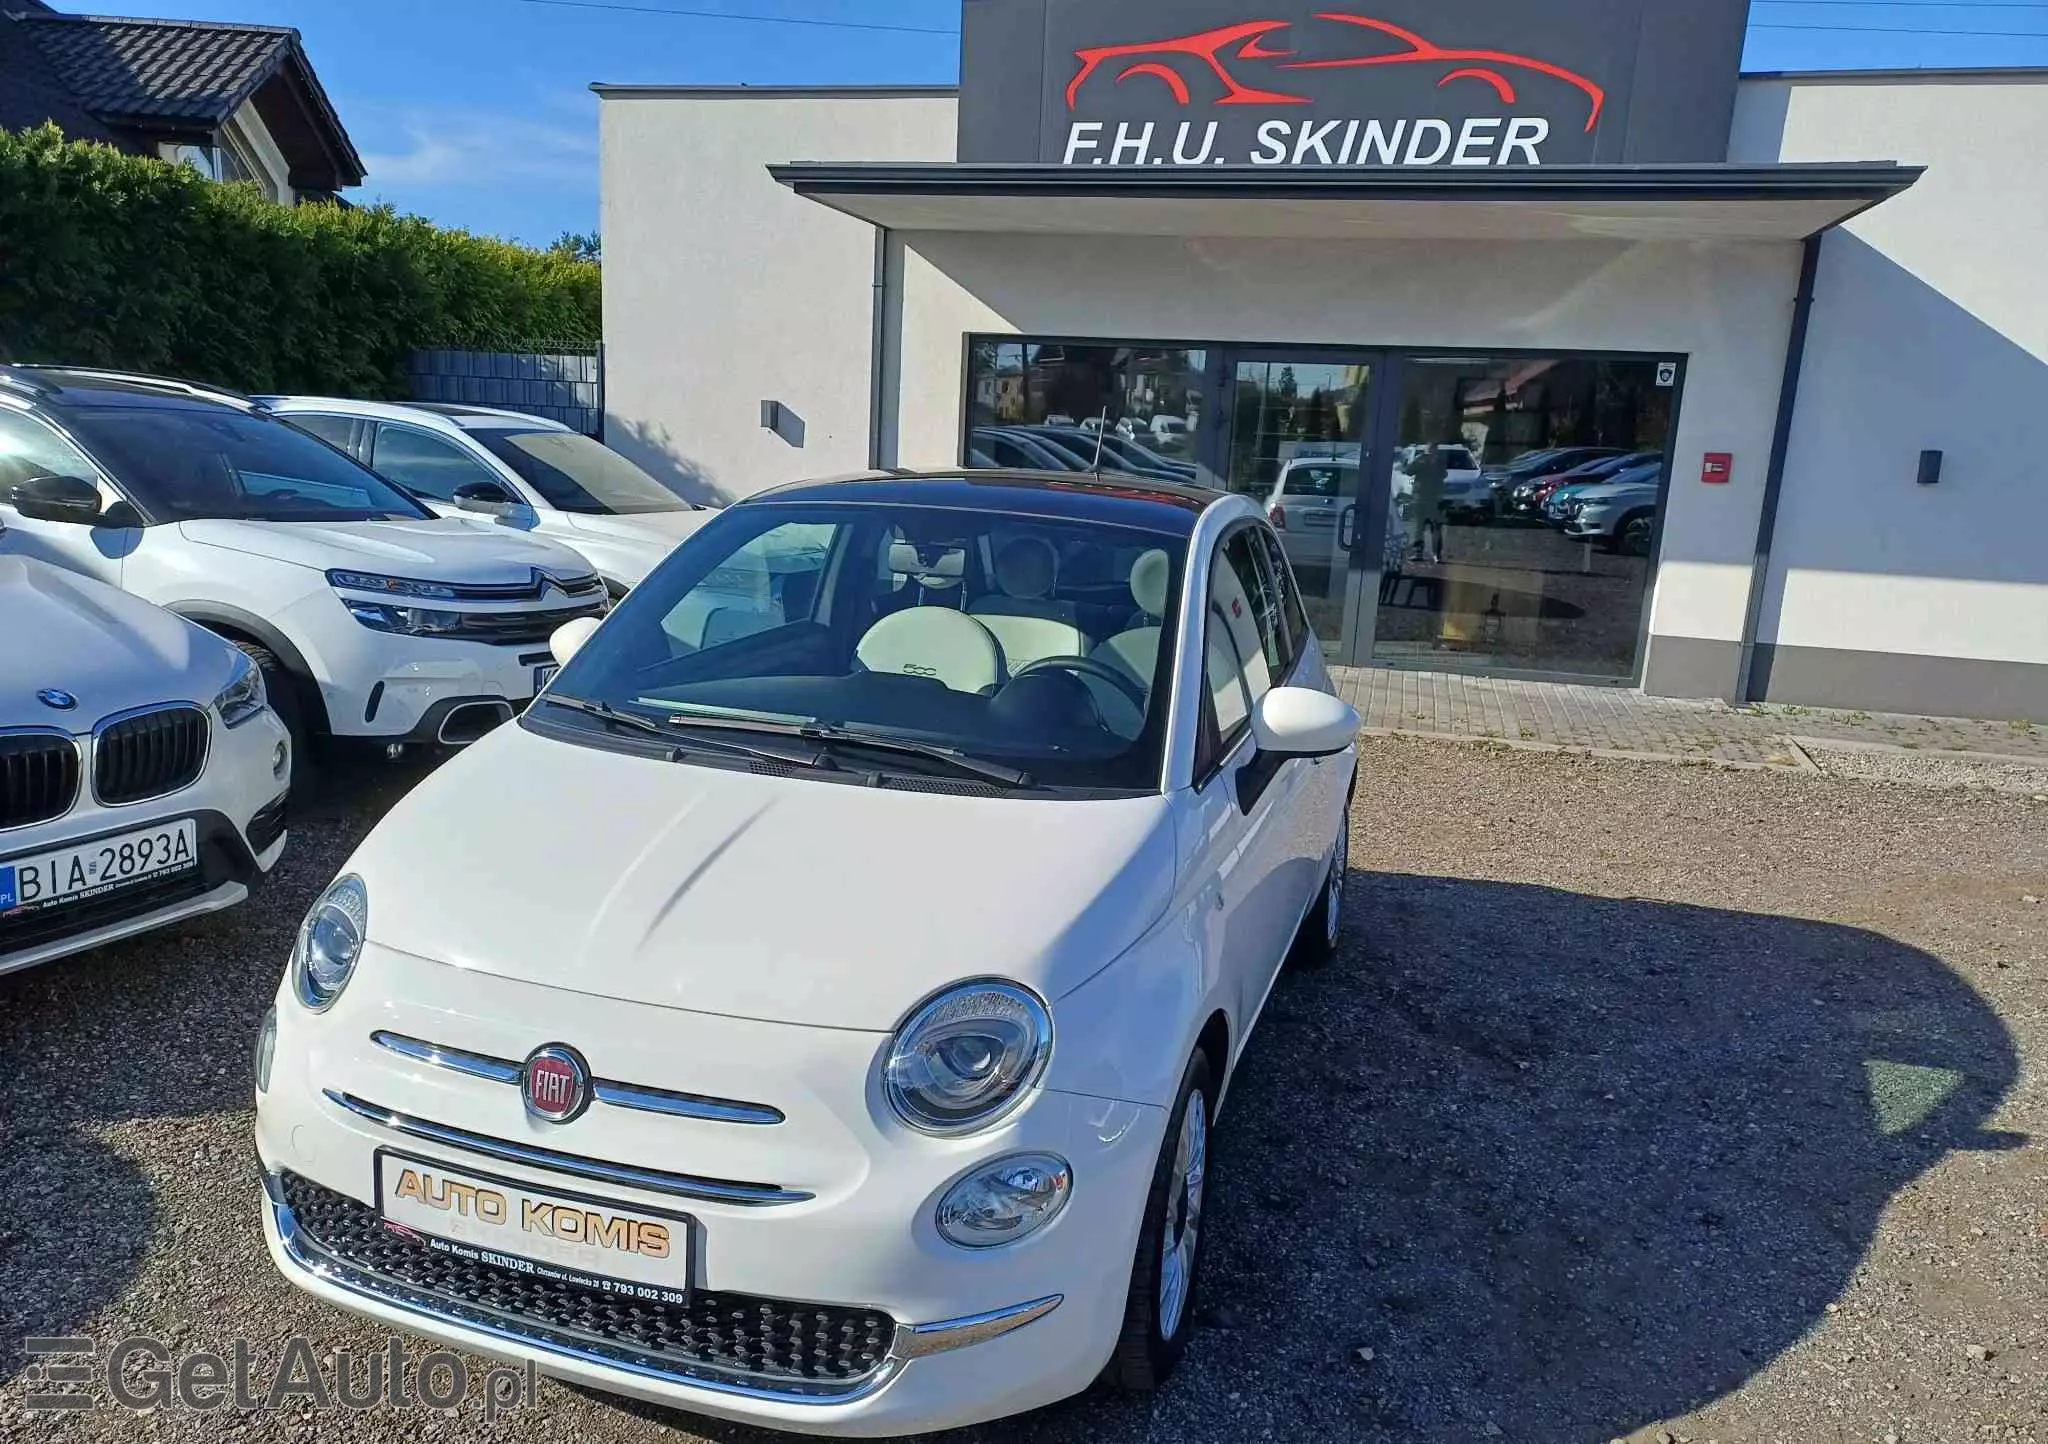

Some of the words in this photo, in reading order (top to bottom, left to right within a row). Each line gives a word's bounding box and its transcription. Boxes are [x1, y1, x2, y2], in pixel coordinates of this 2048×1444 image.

[1063, 121, 1224, 165] F.H.U.
[1250, 117, 1549, 165] SKINDER
[18, 855, 87, 902] BIA
[99, 828, 190, 882] 2893A
[0, 892, 14, 904] PL
[535, 1069, 570, 1104] FIAT
[394, 1168, 506, 1226] AUTO
[521, 1198, 670, 1259] KOMIS
[430, 1238, 450, 1252] Auto
[451, 1244, 479, 1260] Komis
[481, 1251, 535, 1274] SKINDER
[613, 1282, 634, 1296] 793
[637, 1287, 659, 1300] 002
[661, 1291, 683, 1304] 309
